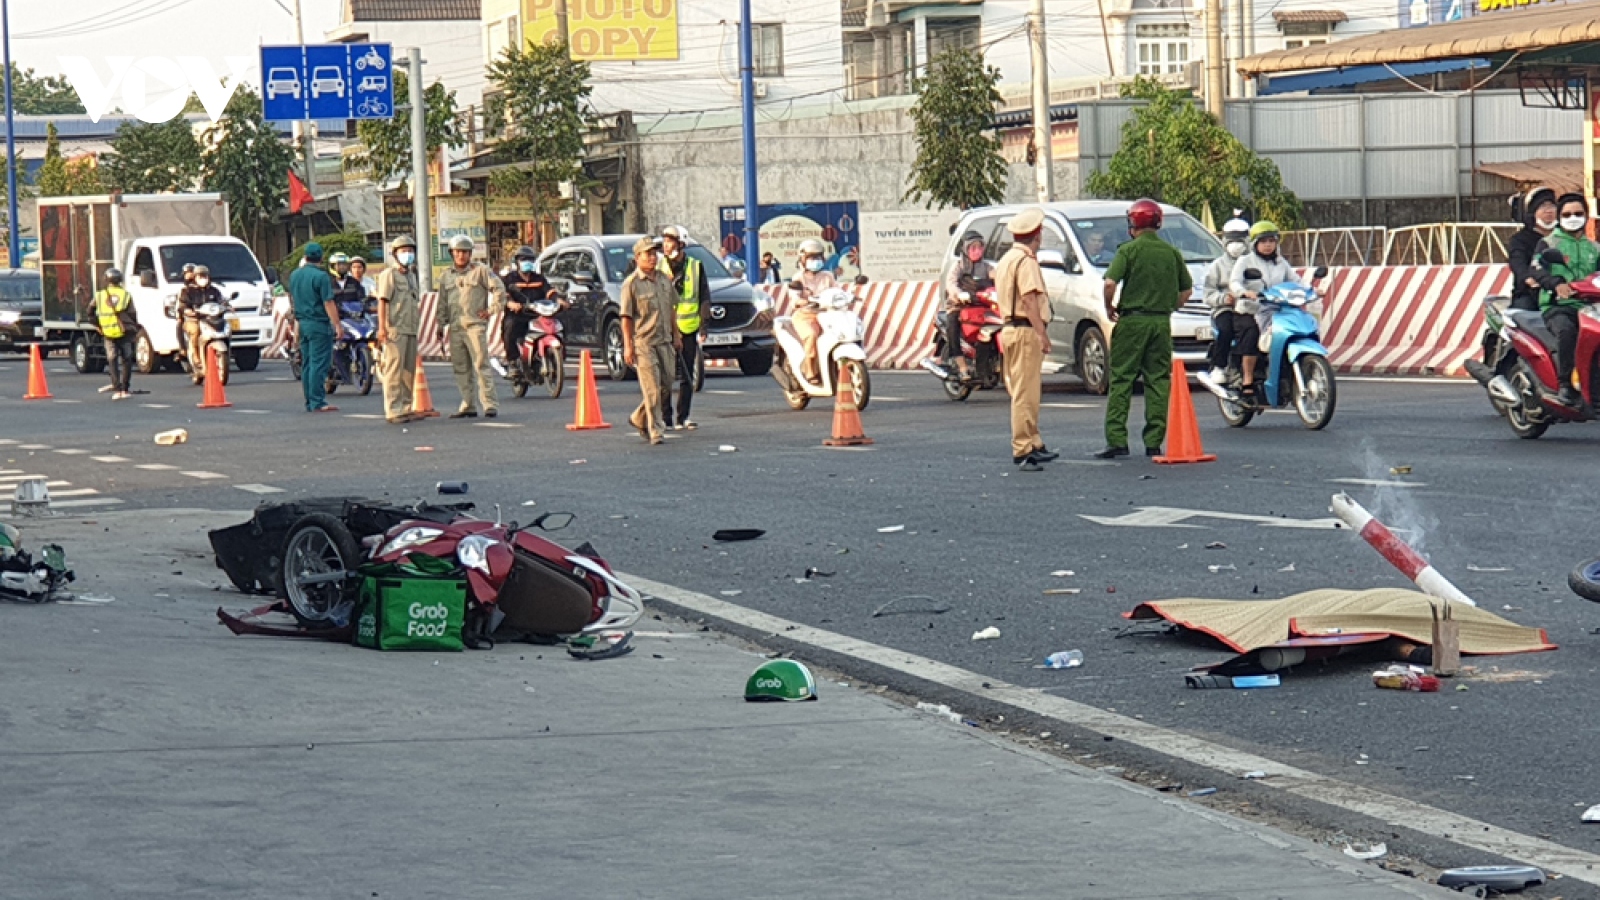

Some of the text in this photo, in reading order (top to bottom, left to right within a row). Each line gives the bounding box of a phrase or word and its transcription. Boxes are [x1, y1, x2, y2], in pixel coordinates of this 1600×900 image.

[440, 199, 482, 213] PHOTO
[908, 229, 933, 237] SINH
[409, 602, 448, 619] Grab
[407, 620, 447, 637] Food
[756, 677, 782, 688] Grab
